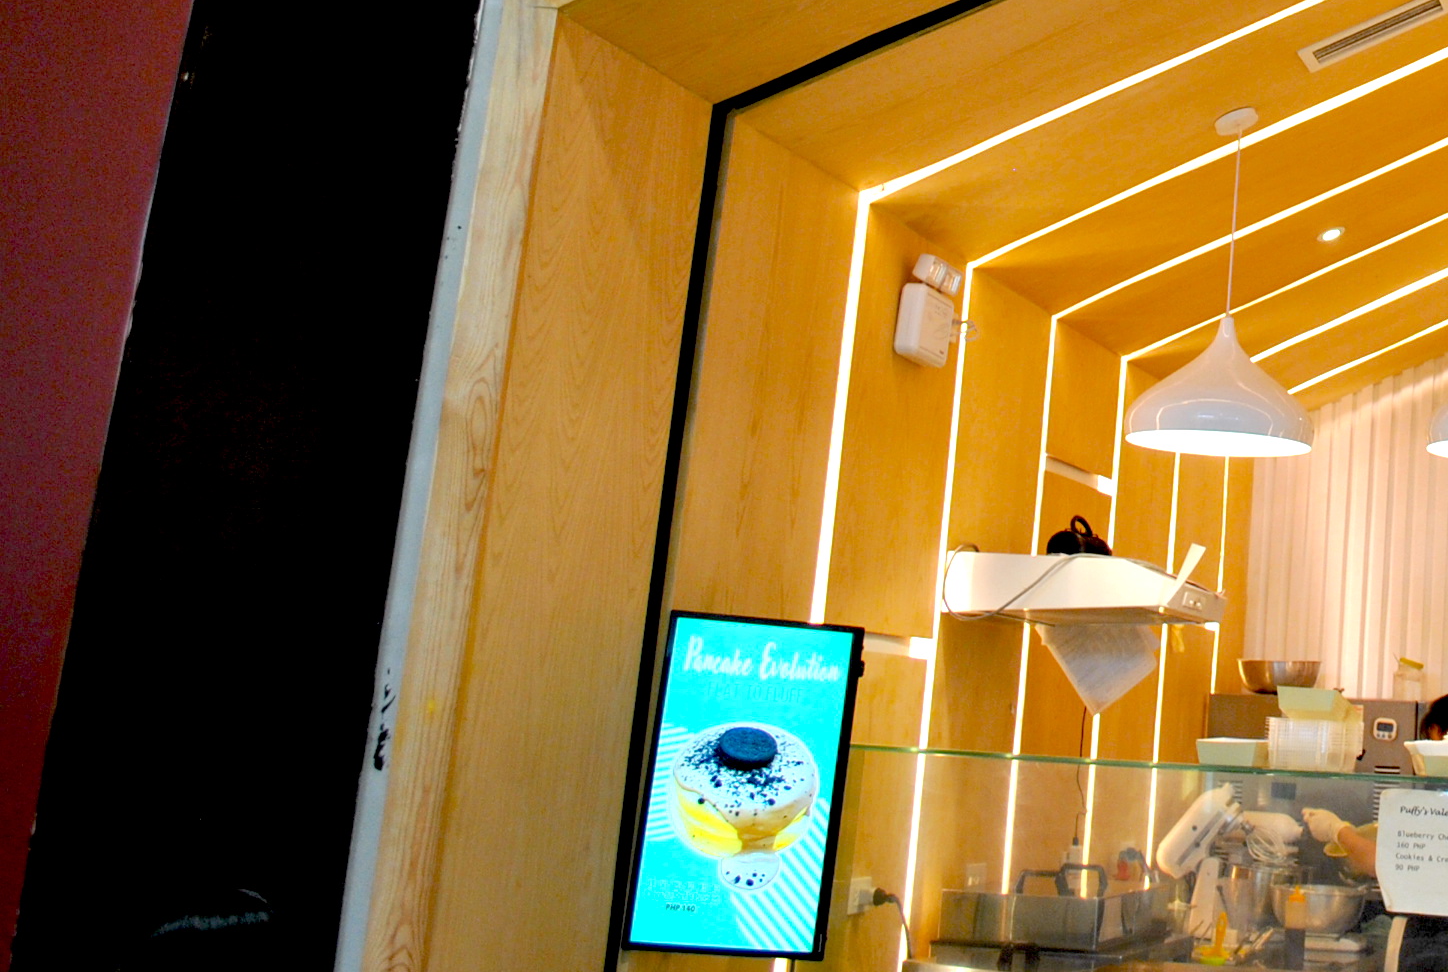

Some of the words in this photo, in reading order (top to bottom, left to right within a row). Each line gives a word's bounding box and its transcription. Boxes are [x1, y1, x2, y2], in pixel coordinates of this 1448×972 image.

[683, 635, 753, 676] Pancake
[759, 641, 840, 682] Evolution
[1400, 806, 1428, 816] Puffy's
[1397, 830, 1434, 840] Blueberry
[1395, 853, 1424, 861] Cookies
